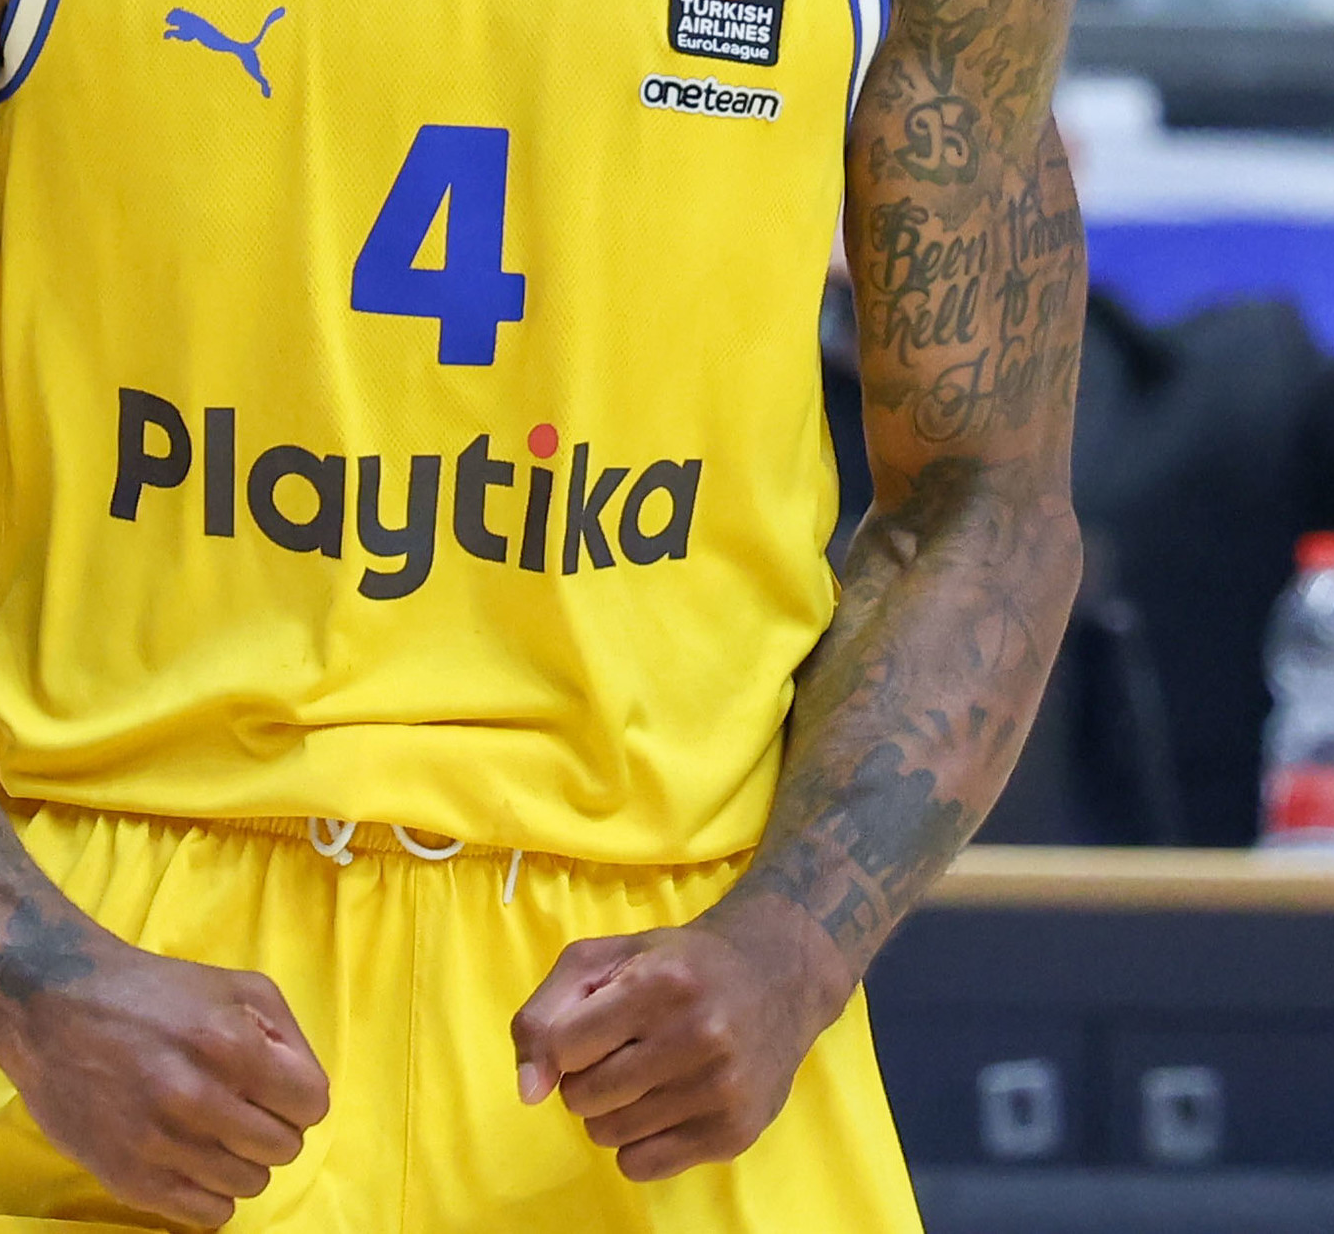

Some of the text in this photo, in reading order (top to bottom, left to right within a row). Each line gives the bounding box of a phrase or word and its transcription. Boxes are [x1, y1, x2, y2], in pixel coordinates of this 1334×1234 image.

[677, 34, 769, 60] EuroLeague
[678, 14, 771, 43] AIRLINES
[644, 78, 779, 117] oneteam
[350, 124, 526, 366] 4
[109, 386, 703, 602] Playtika
